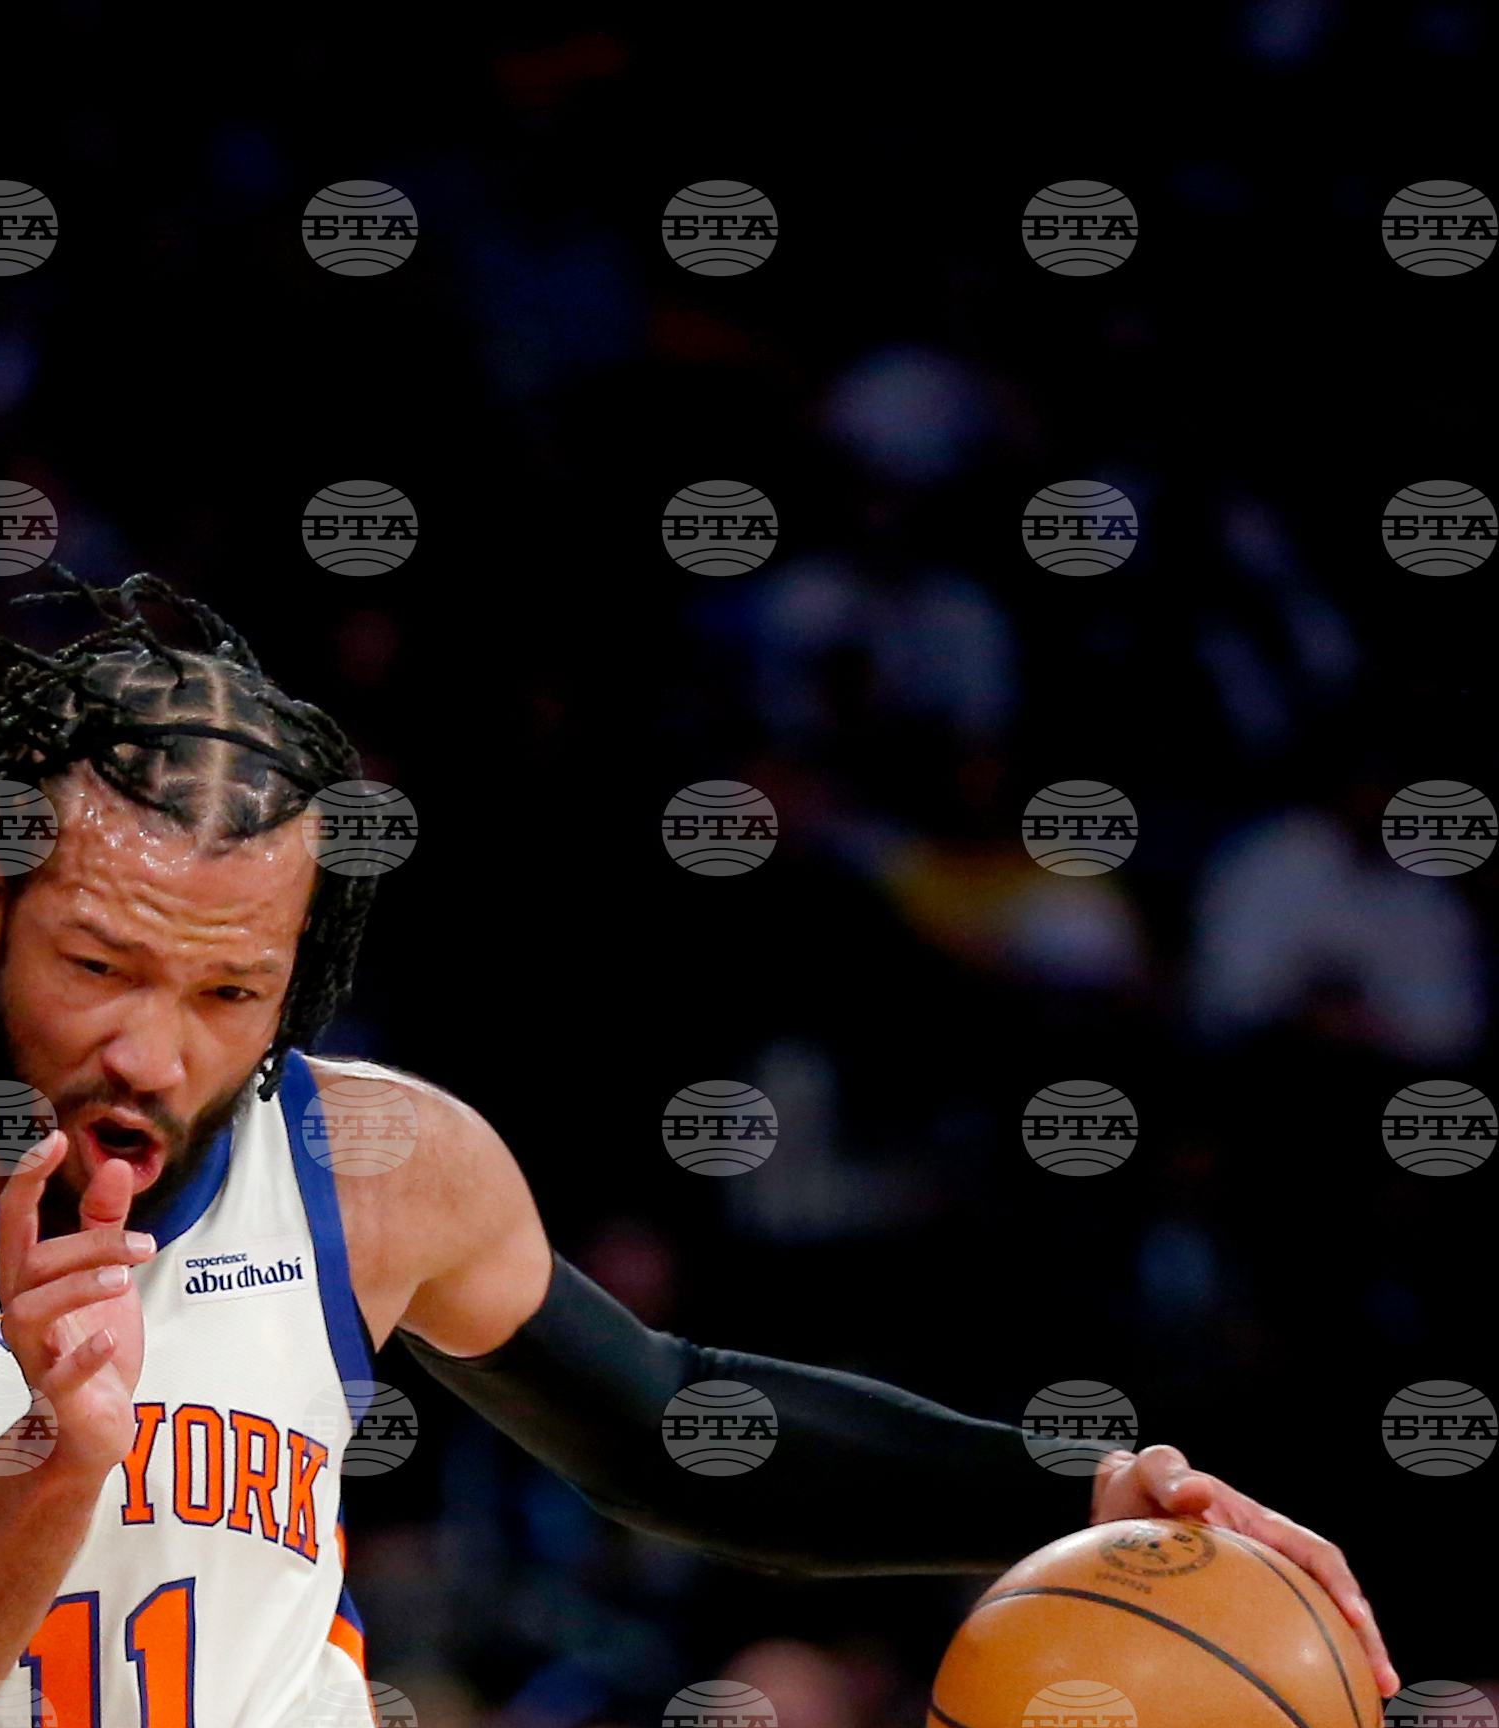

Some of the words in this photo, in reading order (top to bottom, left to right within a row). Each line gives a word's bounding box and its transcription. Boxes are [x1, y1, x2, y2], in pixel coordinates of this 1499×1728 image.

[185, 1253, 247, 1269] experience
[185, 1269, 232, 1294] abu
[236, 1256, 304, 1288] dhabi
[121, 1402, 328, 1565] YORK
